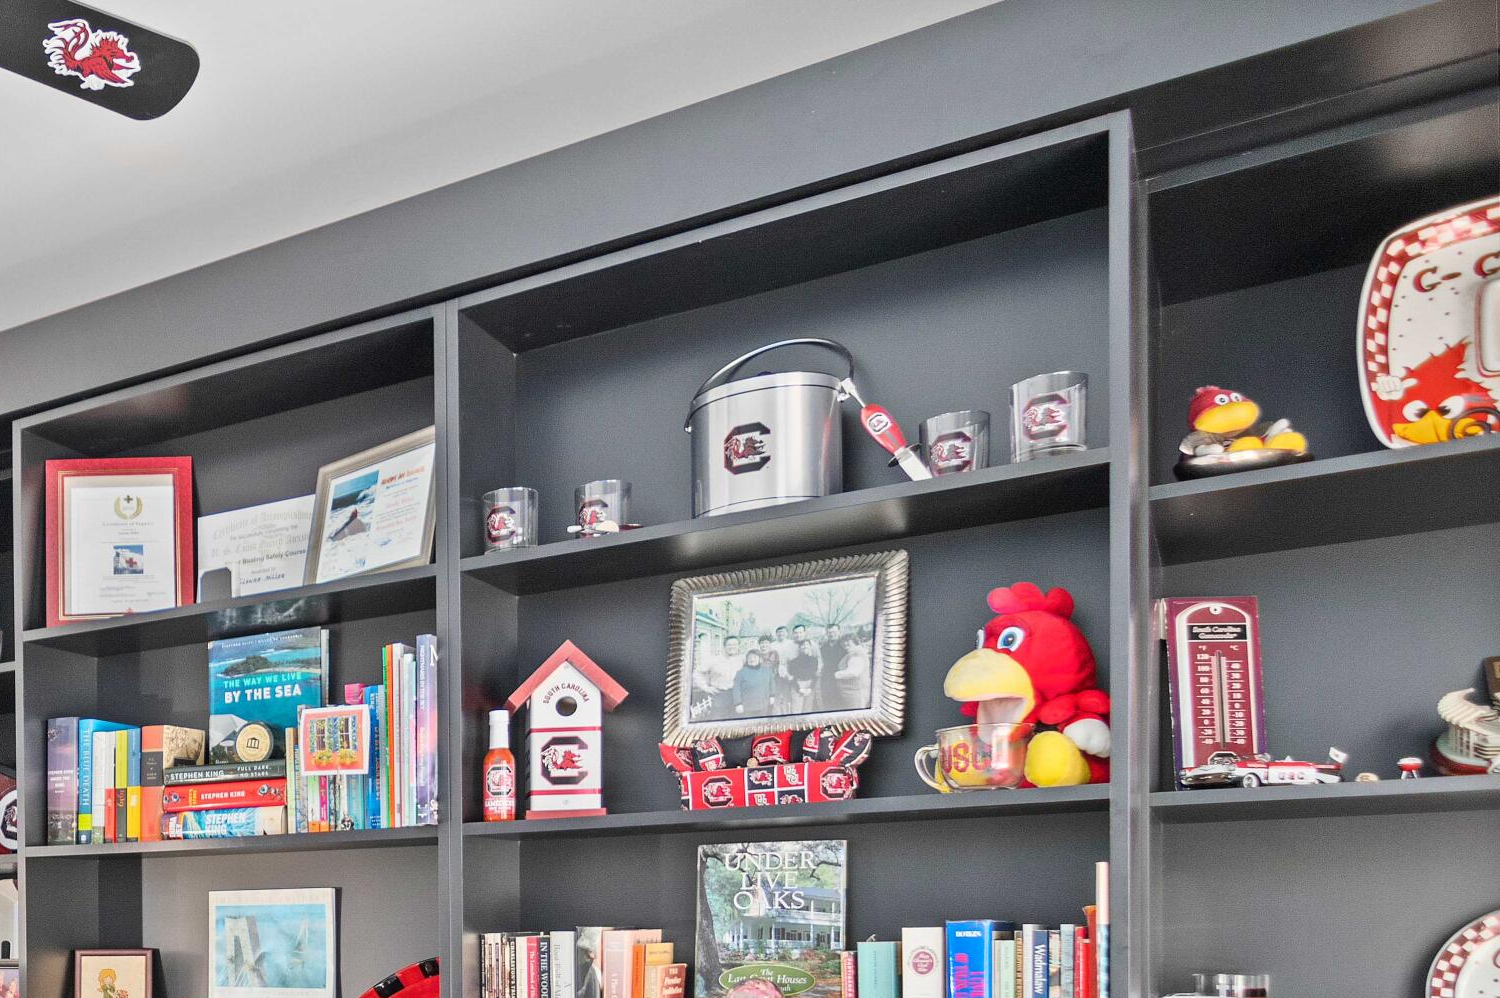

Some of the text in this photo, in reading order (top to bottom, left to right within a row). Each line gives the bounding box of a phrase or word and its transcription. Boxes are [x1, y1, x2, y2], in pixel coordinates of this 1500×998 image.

[224, 672, 302, 689] THE WAY WE LIVE
[224, 683, 302, 704] BY THE SEA
[543, 682, 590, 704] SOUTH CAROLINA
[940, 741, 993, 774] USC
[170, 771, 204, 781] STEPHEN
[205, 770, 225, 778] KING
[83, 776, 91, 806] DEATH
[201, 792, 229, 800] STEPHEN
[229, 790, 245, 798] KING
[205, 813, 247, 824] STEPHEN
[205, 825, 228, 835] KING
[725, 850, 816, 871] UNDER
[741, 871, 798, 890] LIVE
[733, 890, 805, 910] OAKS
[539, 941, 546, 953] IN
[761, 968, 774, 977] The
[1034, 944, 1047, 994] Wadmalaw
[776, 974, 808, 984] Houses
